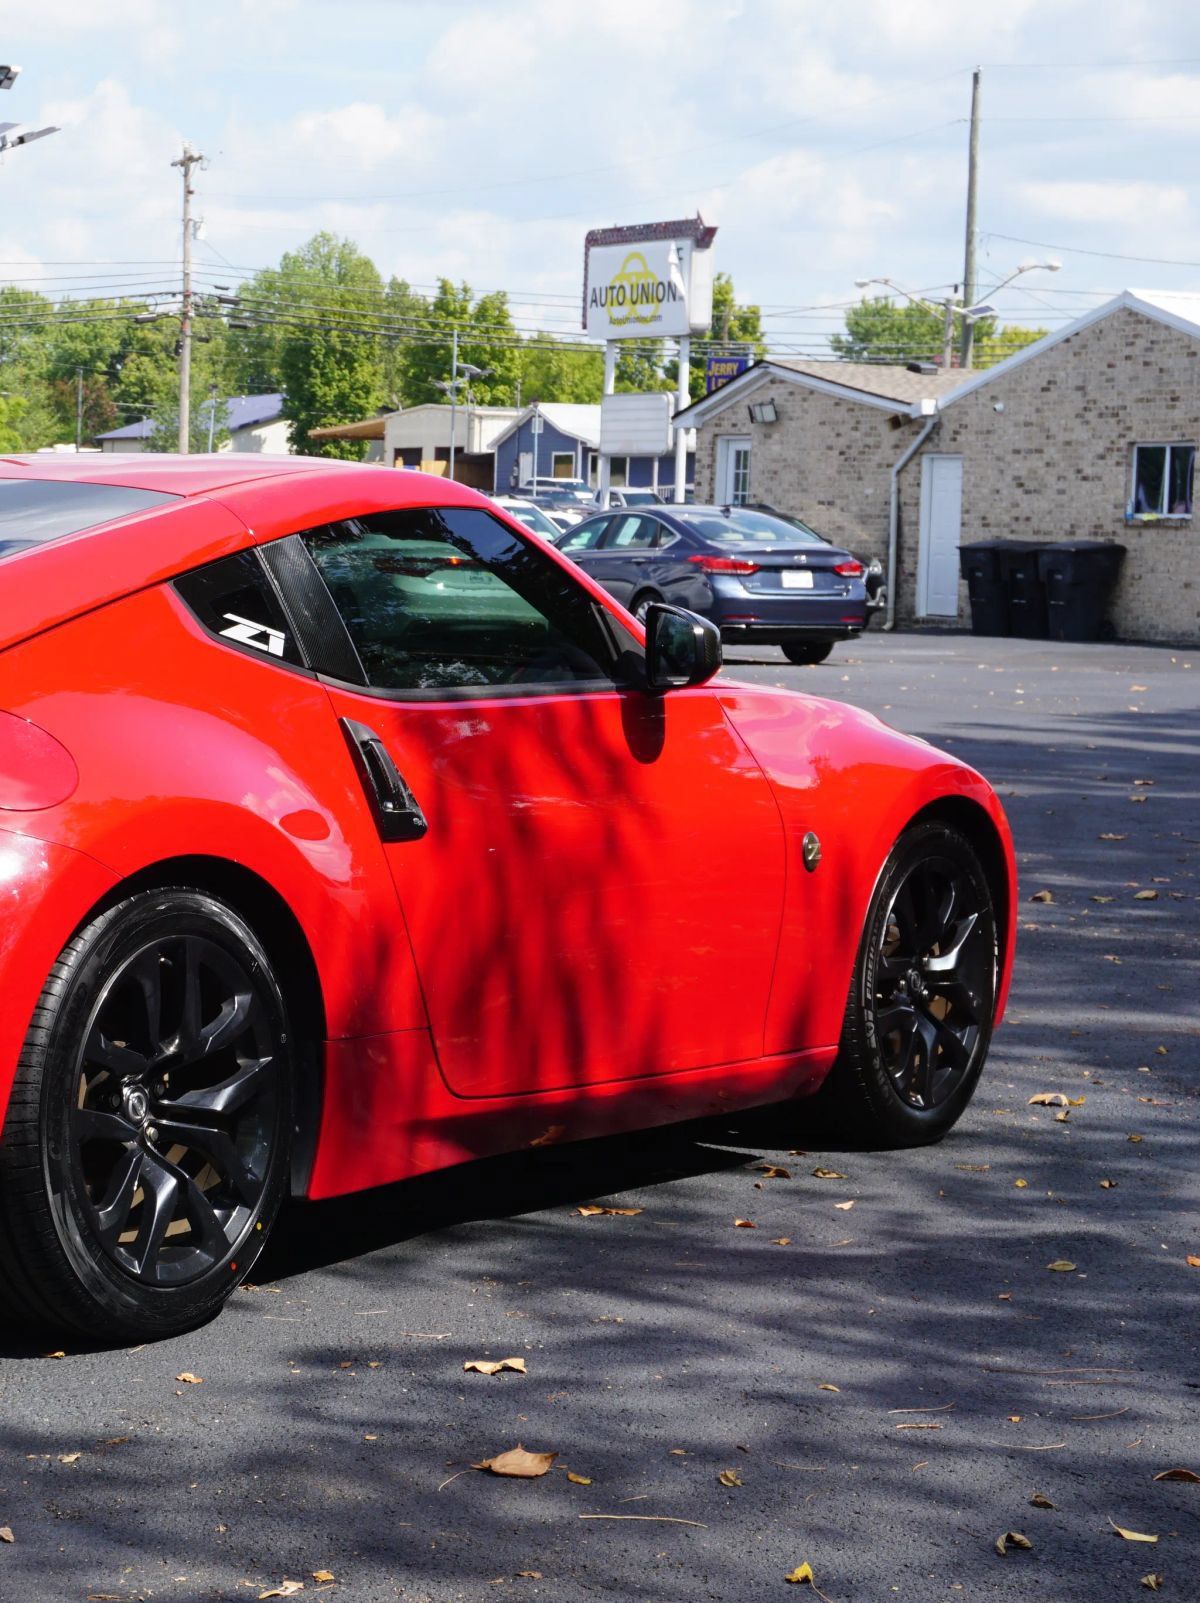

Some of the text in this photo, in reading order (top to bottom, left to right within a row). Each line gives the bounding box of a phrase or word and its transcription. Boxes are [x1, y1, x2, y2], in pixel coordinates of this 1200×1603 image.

[590, 280, 677, 309] AUTO UNION
[709, 361, 739, 376] JERRY
